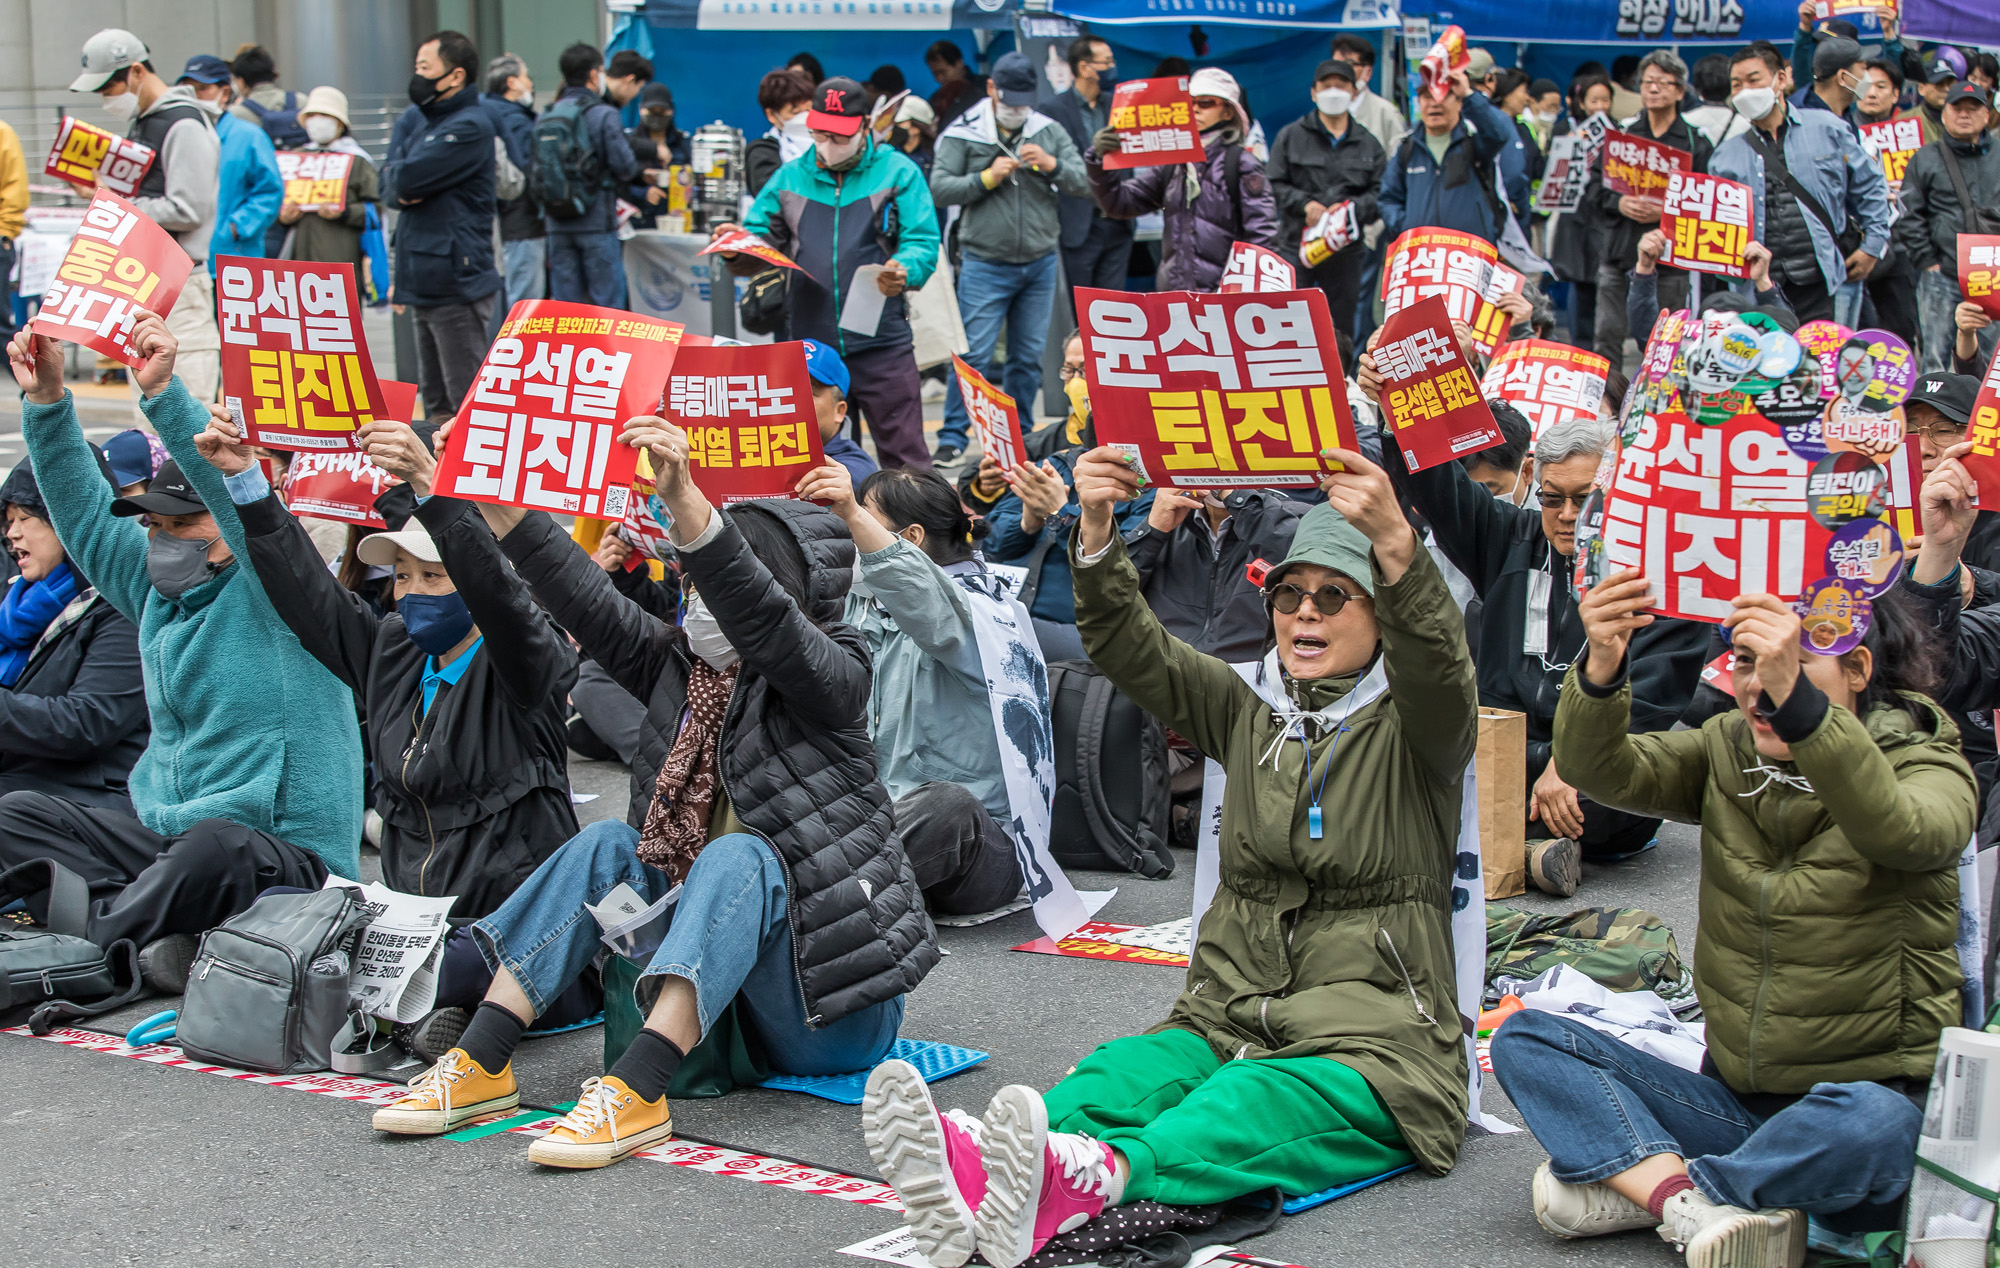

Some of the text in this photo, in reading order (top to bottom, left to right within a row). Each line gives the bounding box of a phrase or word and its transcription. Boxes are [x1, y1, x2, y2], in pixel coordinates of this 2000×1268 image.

[1663, 173, 1749, 228] 윤석열
[1673, 216, 1749, 267] 퇴진!
[59, 238, 161, 304] 동의
[1388, 247, 1484, 291] 윤석열
[221, 265, 357, 353] 윤석열
[556, 316, 614, 336] 평화파괴
[614, 320, 684, 346] 친일매국
[1088, 299, 1328, 390] 윤석열
[1372, 327, 1457, 383] 특등매국노
[249, 349, 375, 431] 퇴진!
[474, 338, 632, 420] 윤석열
[670, 375, 796, 418] 특등매국노
[1388, 366, 1480, 430] 윤석열 퇴진
[1481, 361, 1586, 409] 윤석열
[1925, 380, 1944, 393] W
[738, 421, 811, 468] 퇴진
[1148, 387, 1345, 472] 퇴진!
[453, 408, 614, 515] 퇴진!
[1614, 412, 1809, 513] 윤석열
[1808, 469, 1877, 496] 퇴진이
[1602, 495, 1807, 618] 퇴진!
[1829, 539, 1881, 561] 윤석열
[1836, 559, 1874, 579] 해고
[367, 930, 432, 949] 한미동맹 도박은
[375, 949, 405, 964] 안전을
[356, 962, 406, 979] 거는 것이다
[665, 1143, 873, 1195] 위험 안전제일
